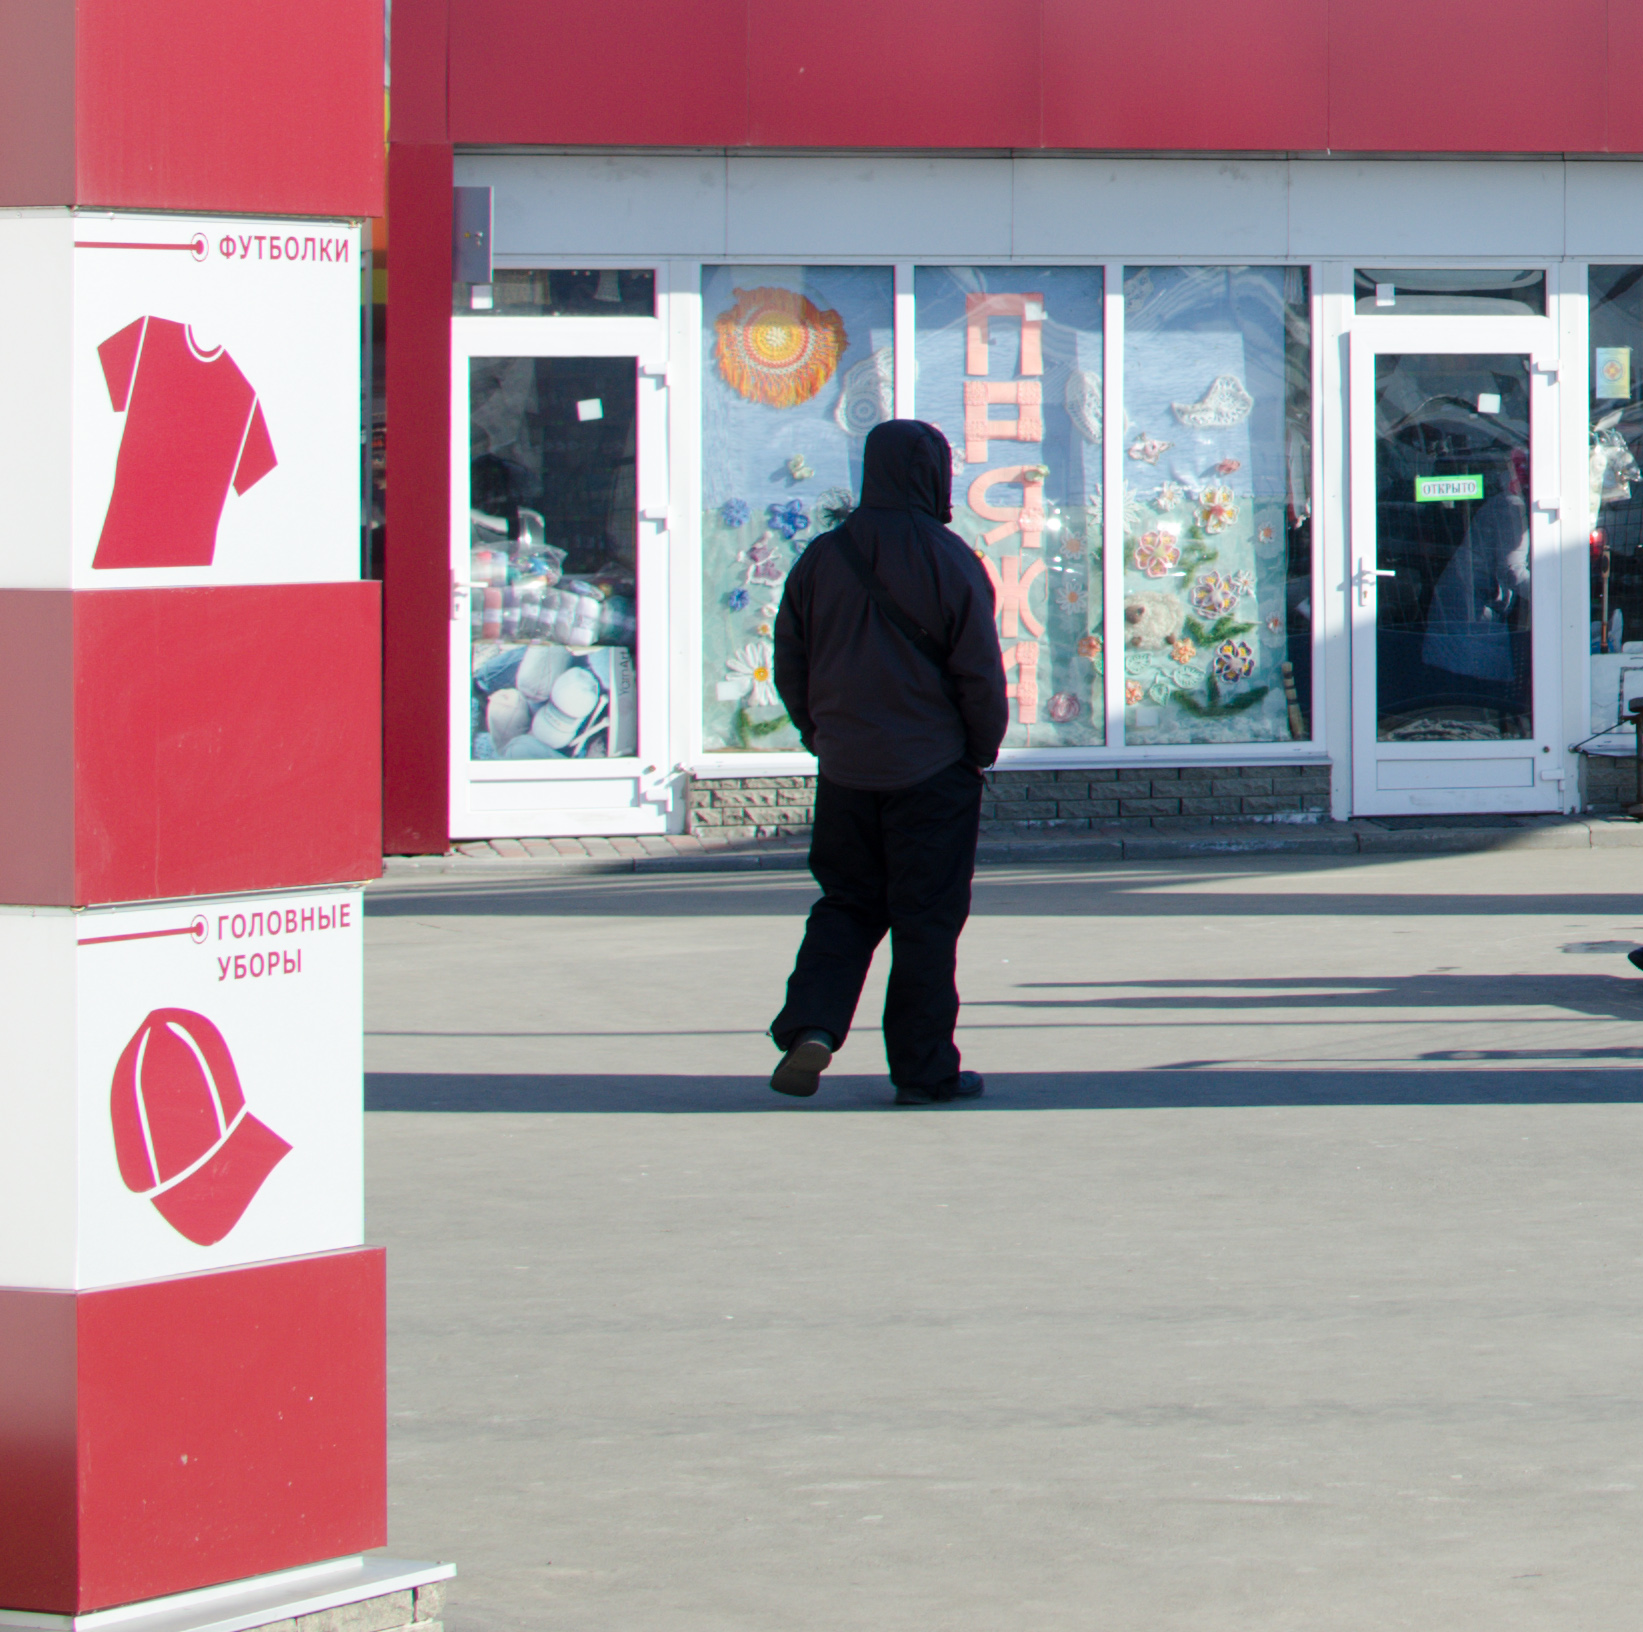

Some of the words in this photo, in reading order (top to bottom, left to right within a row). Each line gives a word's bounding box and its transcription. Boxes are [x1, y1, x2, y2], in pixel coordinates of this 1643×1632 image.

[219, 235, 349, 263] ФУТБОЛКИ
[1422, 479, 1476, 496] ОТКРЫТО
[217, 903, 351, 940] ГОЛОВНЫЕ
[217, 949, 301, 981] УБОРЫ
